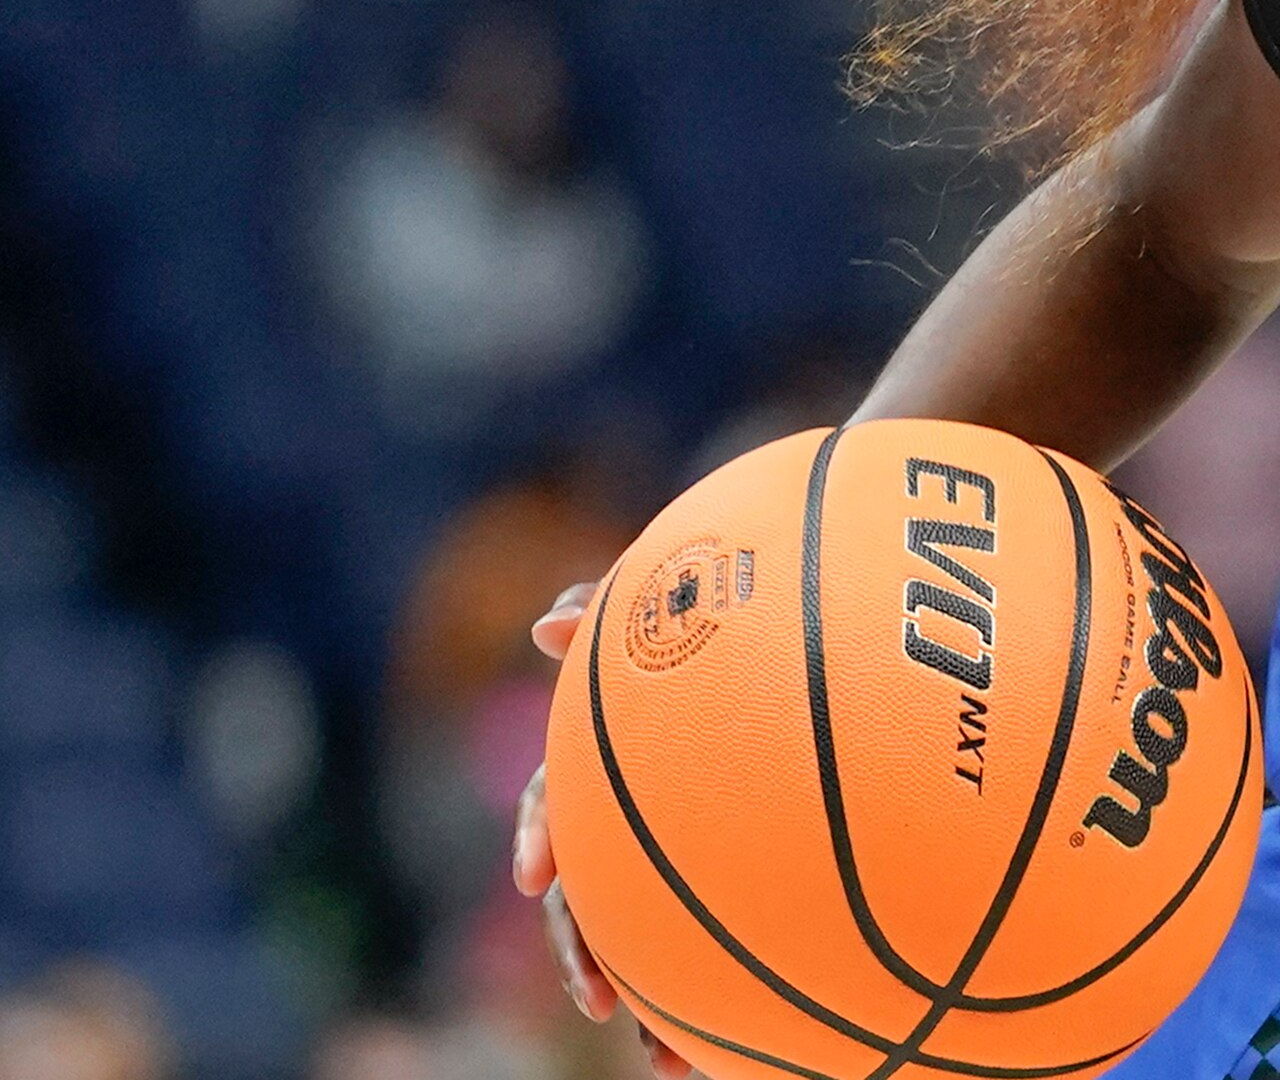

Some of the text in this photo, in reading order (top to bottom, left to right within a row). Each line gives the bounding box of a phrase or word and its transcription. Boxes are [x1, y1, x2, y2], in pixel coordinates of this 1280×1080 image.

[902, 456, 997, 796] EVO NXT
[1123, 592, 1136, 649] GAME
[1110, 654, 1131, 706] BALL
